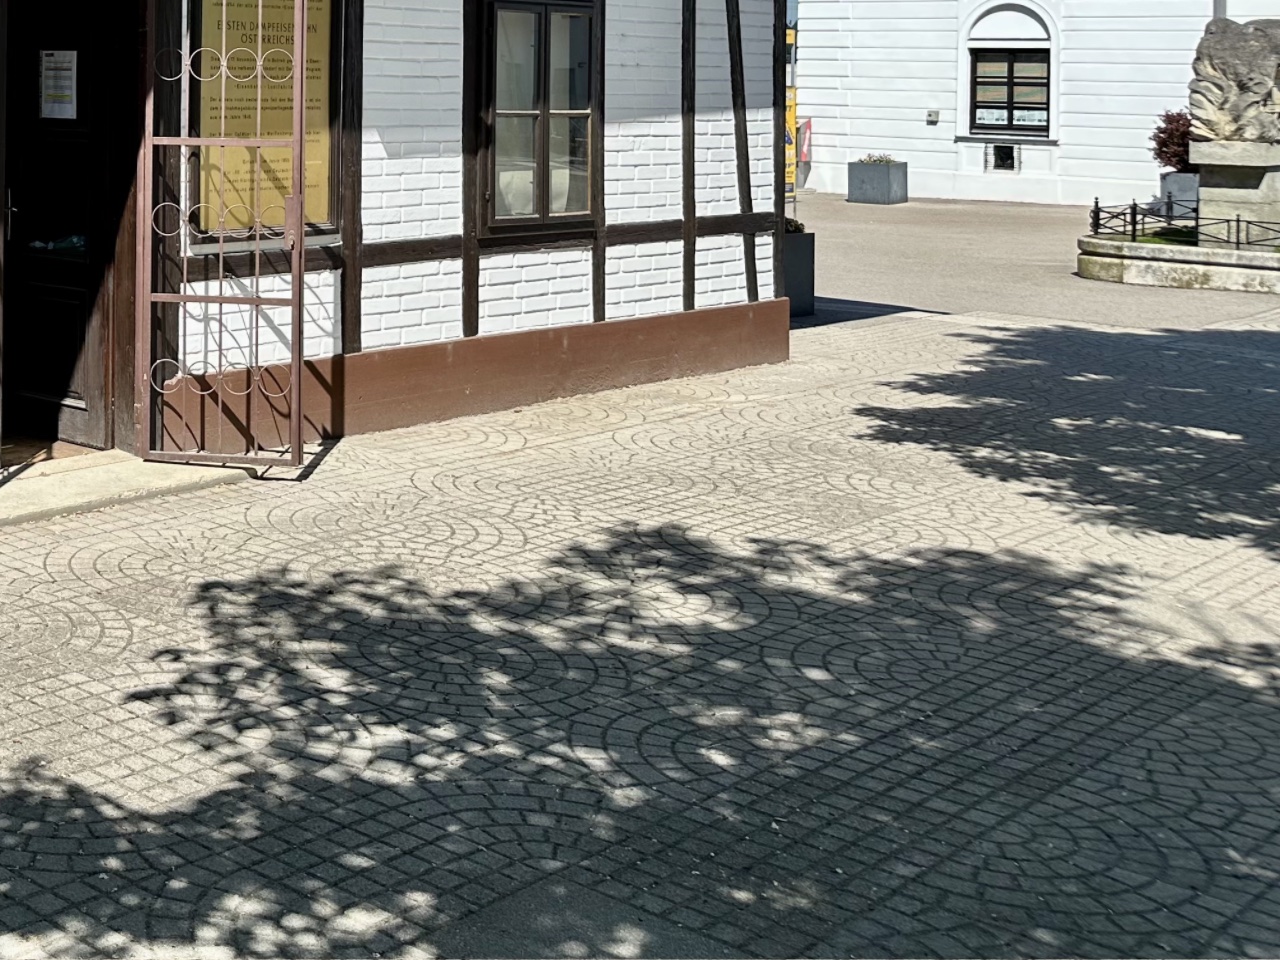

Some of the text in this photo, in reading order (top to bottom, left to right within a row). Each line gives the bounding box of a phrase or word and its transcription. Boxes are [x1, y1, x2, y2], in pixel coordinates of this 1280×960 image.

[217, 20, 317, 34] ESTEN DAMPFEISEHN
[240, 32, 295, 45] ÖSTRREICHS
